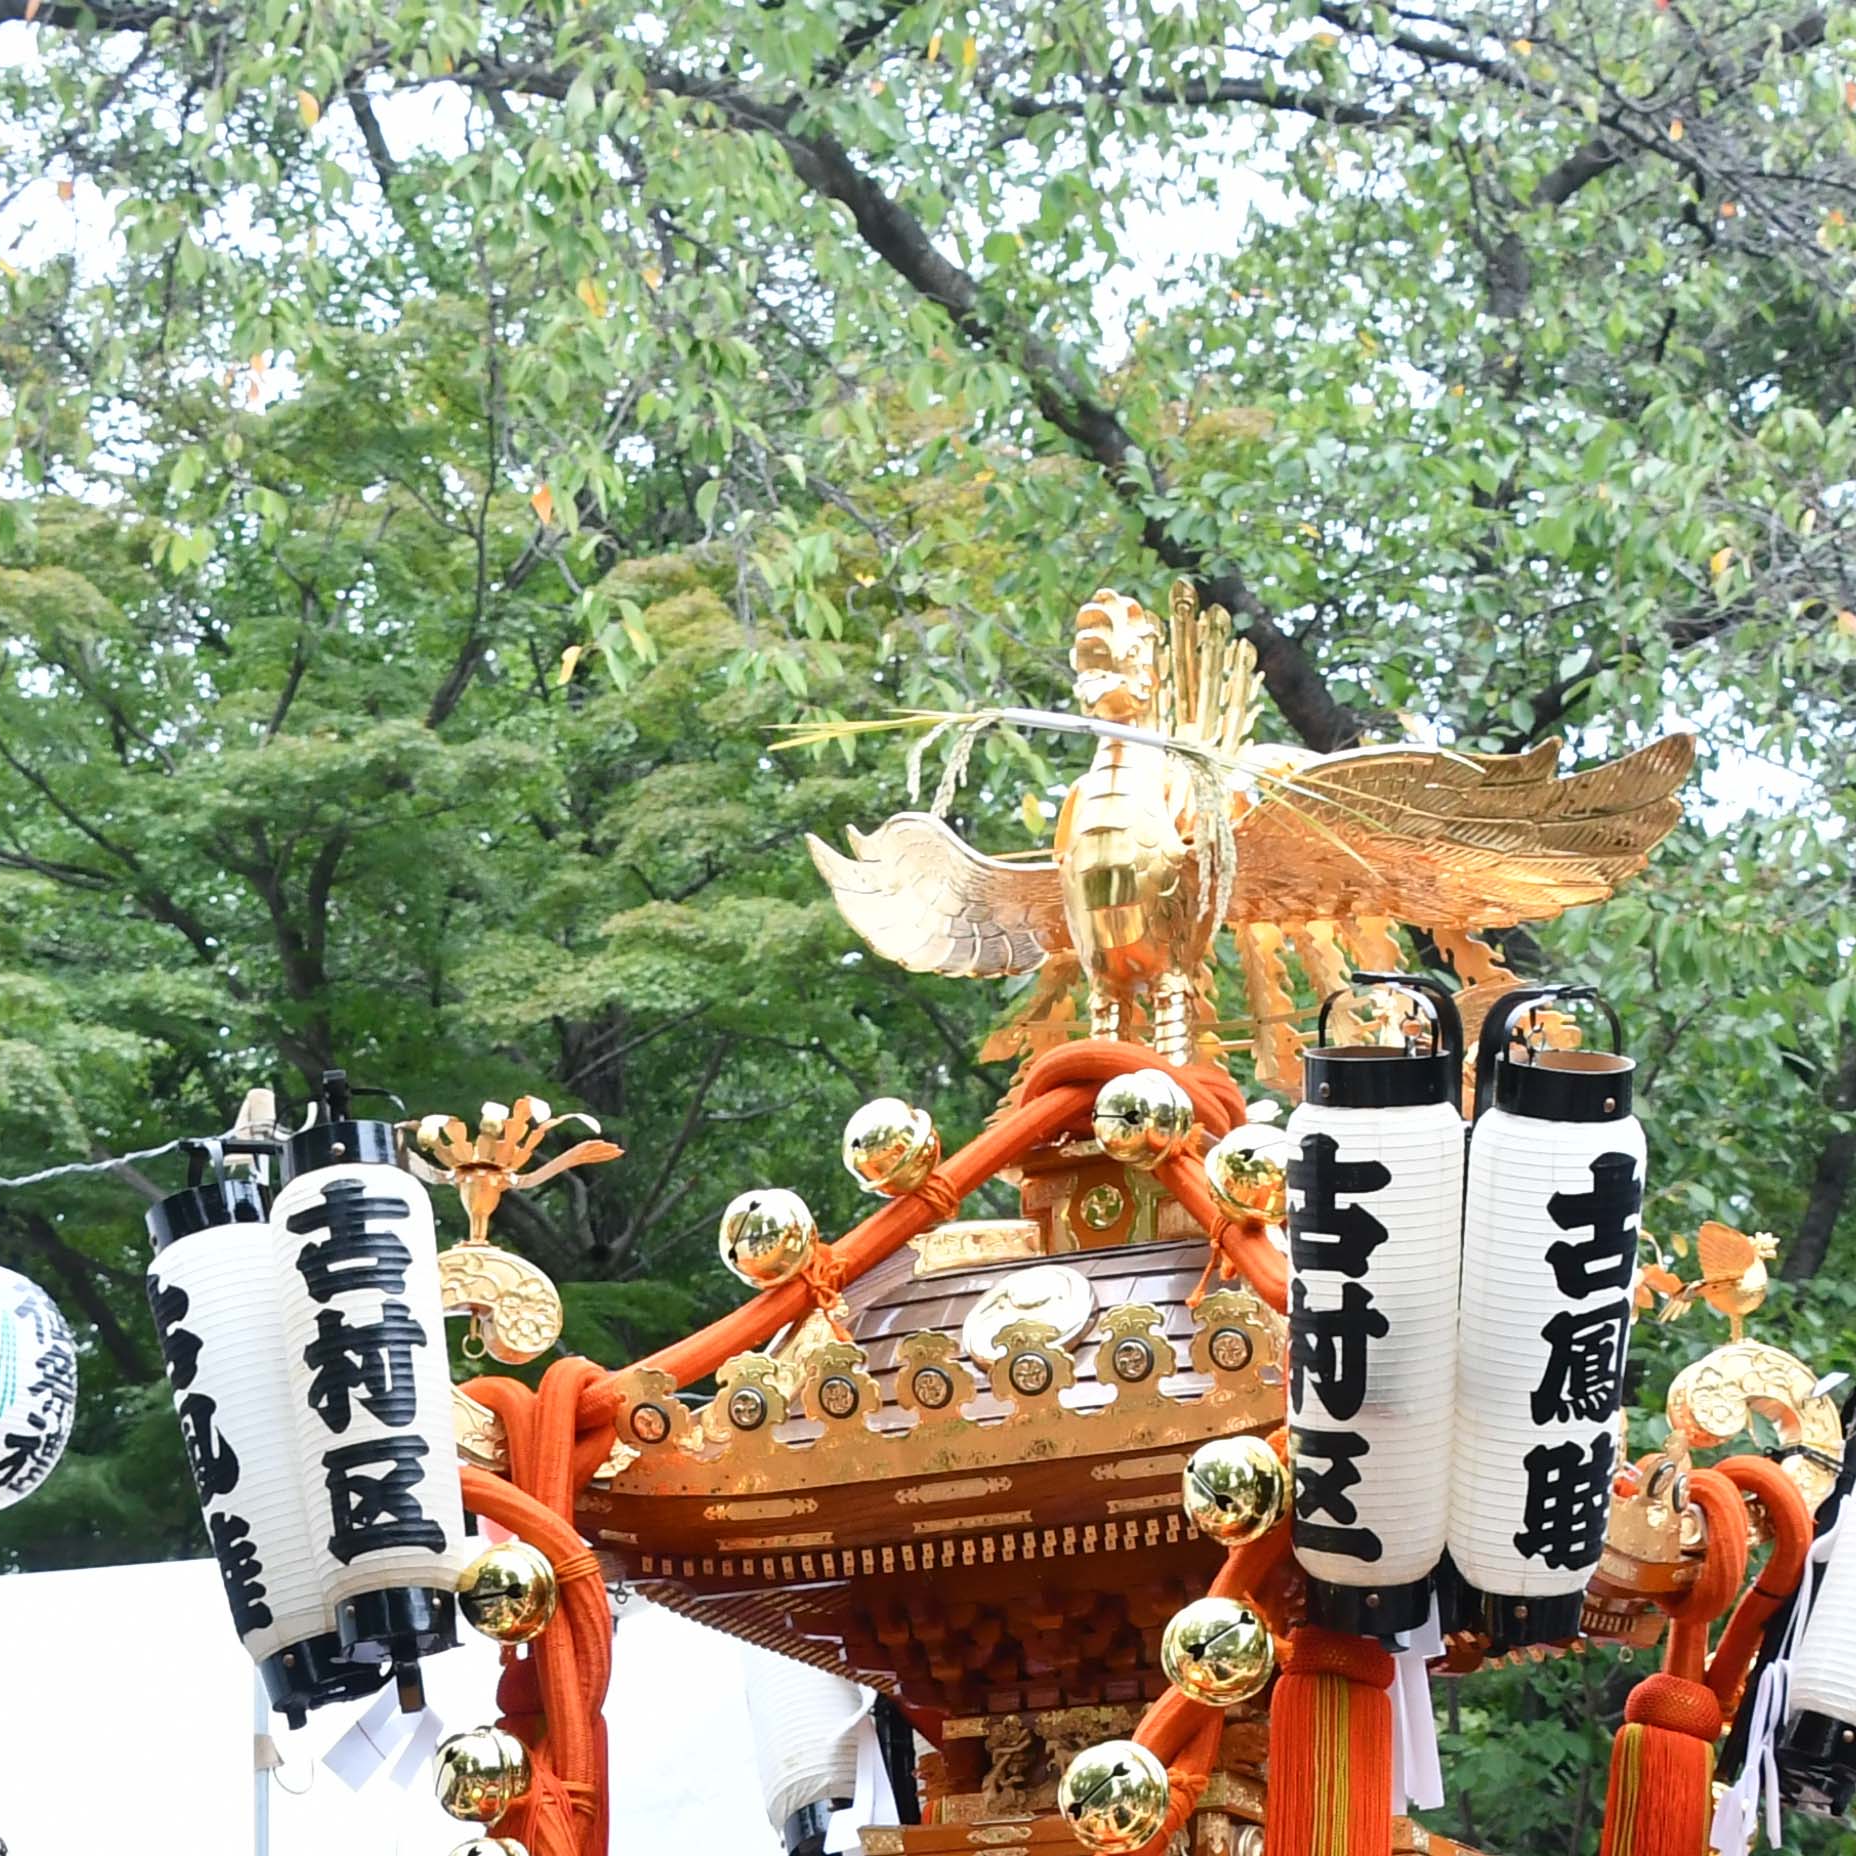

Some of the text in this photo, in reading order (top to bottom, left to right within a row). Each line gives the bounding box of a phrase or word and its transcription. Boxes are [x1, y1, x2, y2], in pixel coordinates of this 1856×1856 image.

[287, 1179, 447, 1566] 古村区
[1288, 1133, 1392, 1562] 古村区
